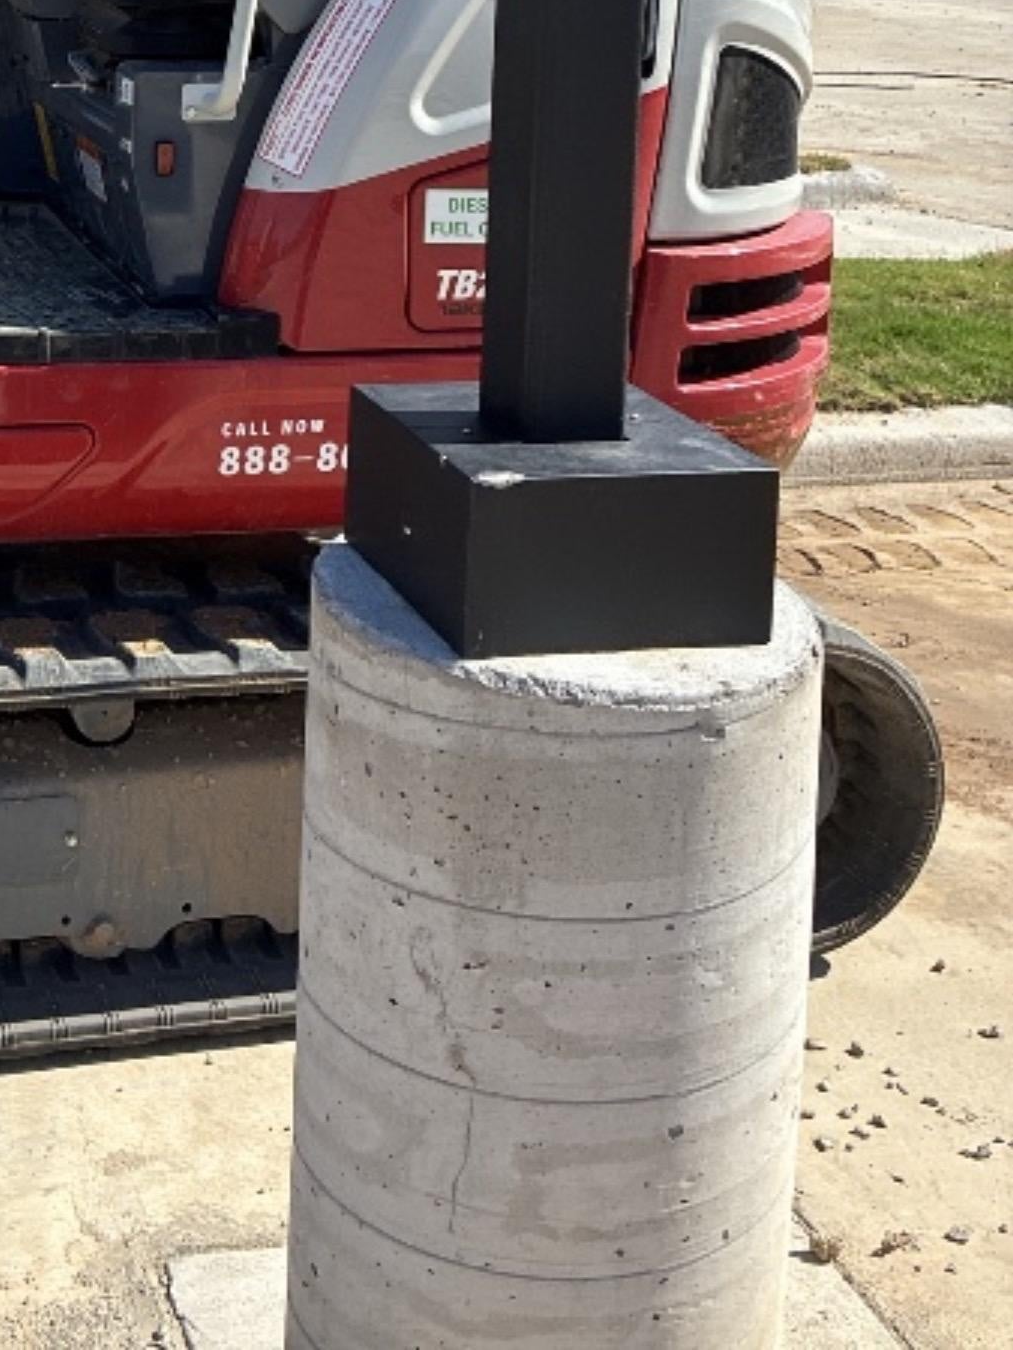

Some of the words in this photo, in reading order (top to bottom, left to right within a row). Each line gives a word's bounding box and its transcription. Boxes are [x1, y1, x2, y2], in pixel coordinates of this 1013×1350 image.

[430, 221, 473, 237] FUEL
[220, 420, 271, 437] CALL
[280, 418, 326, 435] NOW
